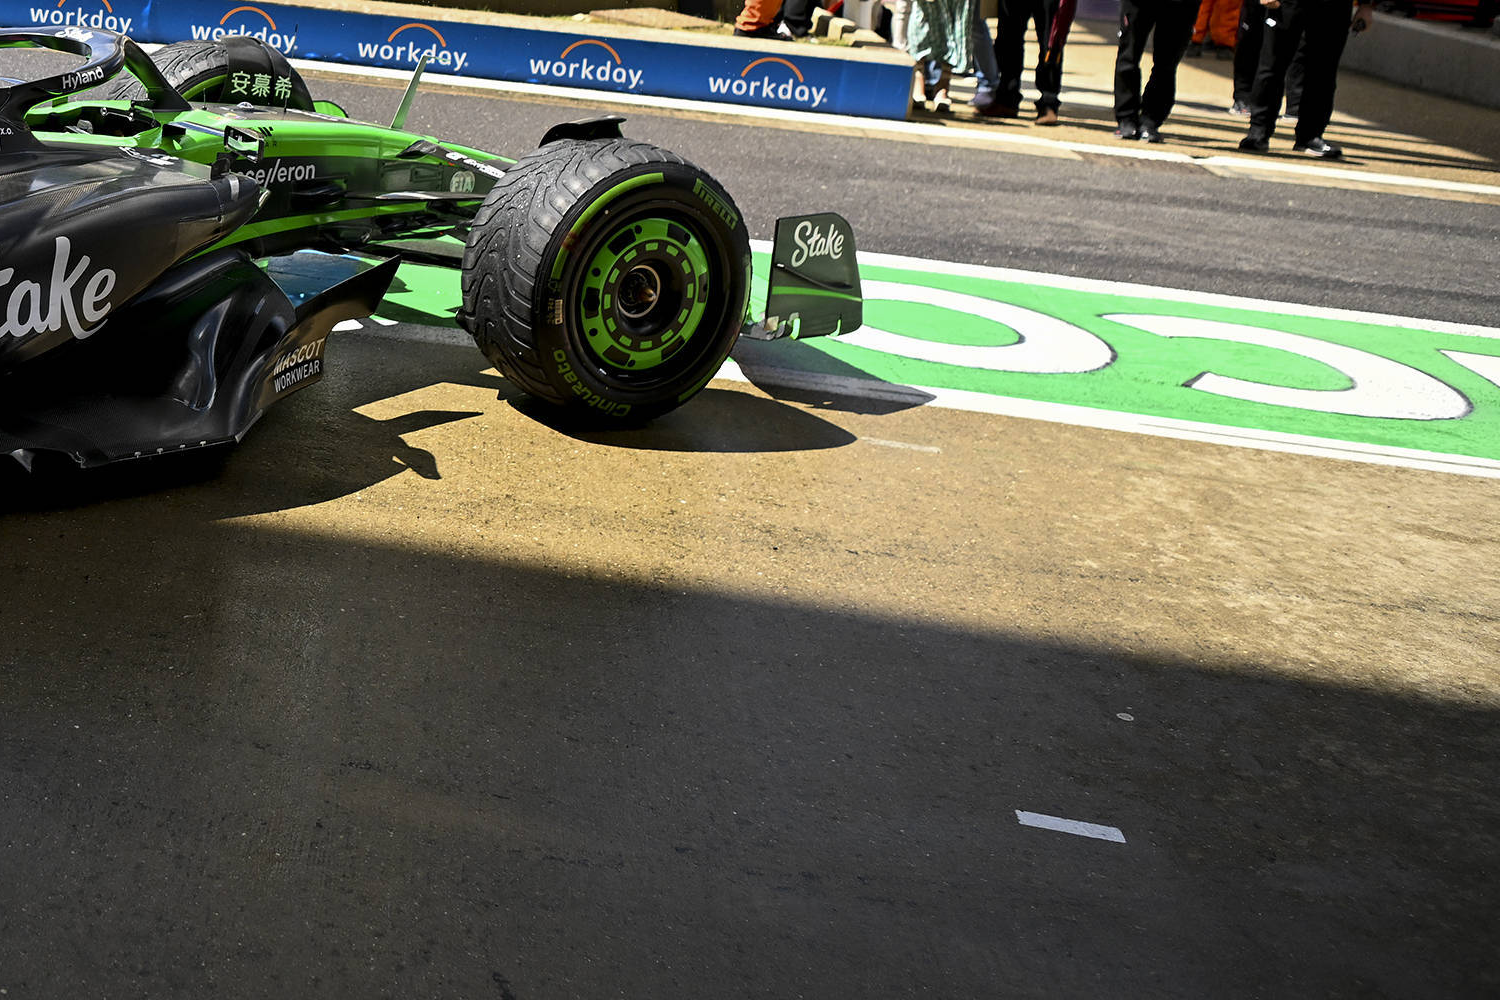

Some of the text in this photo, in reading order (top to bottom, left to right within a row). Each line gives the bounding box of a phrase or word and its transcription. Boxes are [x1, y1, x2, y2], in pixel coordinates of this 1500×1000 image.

[62, 66, 105, 90] Hyland
[230, 70, 293, 100] 安慕希
[692, 177, 739, 231] PIRELLI
[791, 220, 845, 268] Stake
[273, 336, 326, 376] MASCOT
[273, 359, 320, 393] WORKWEAR
